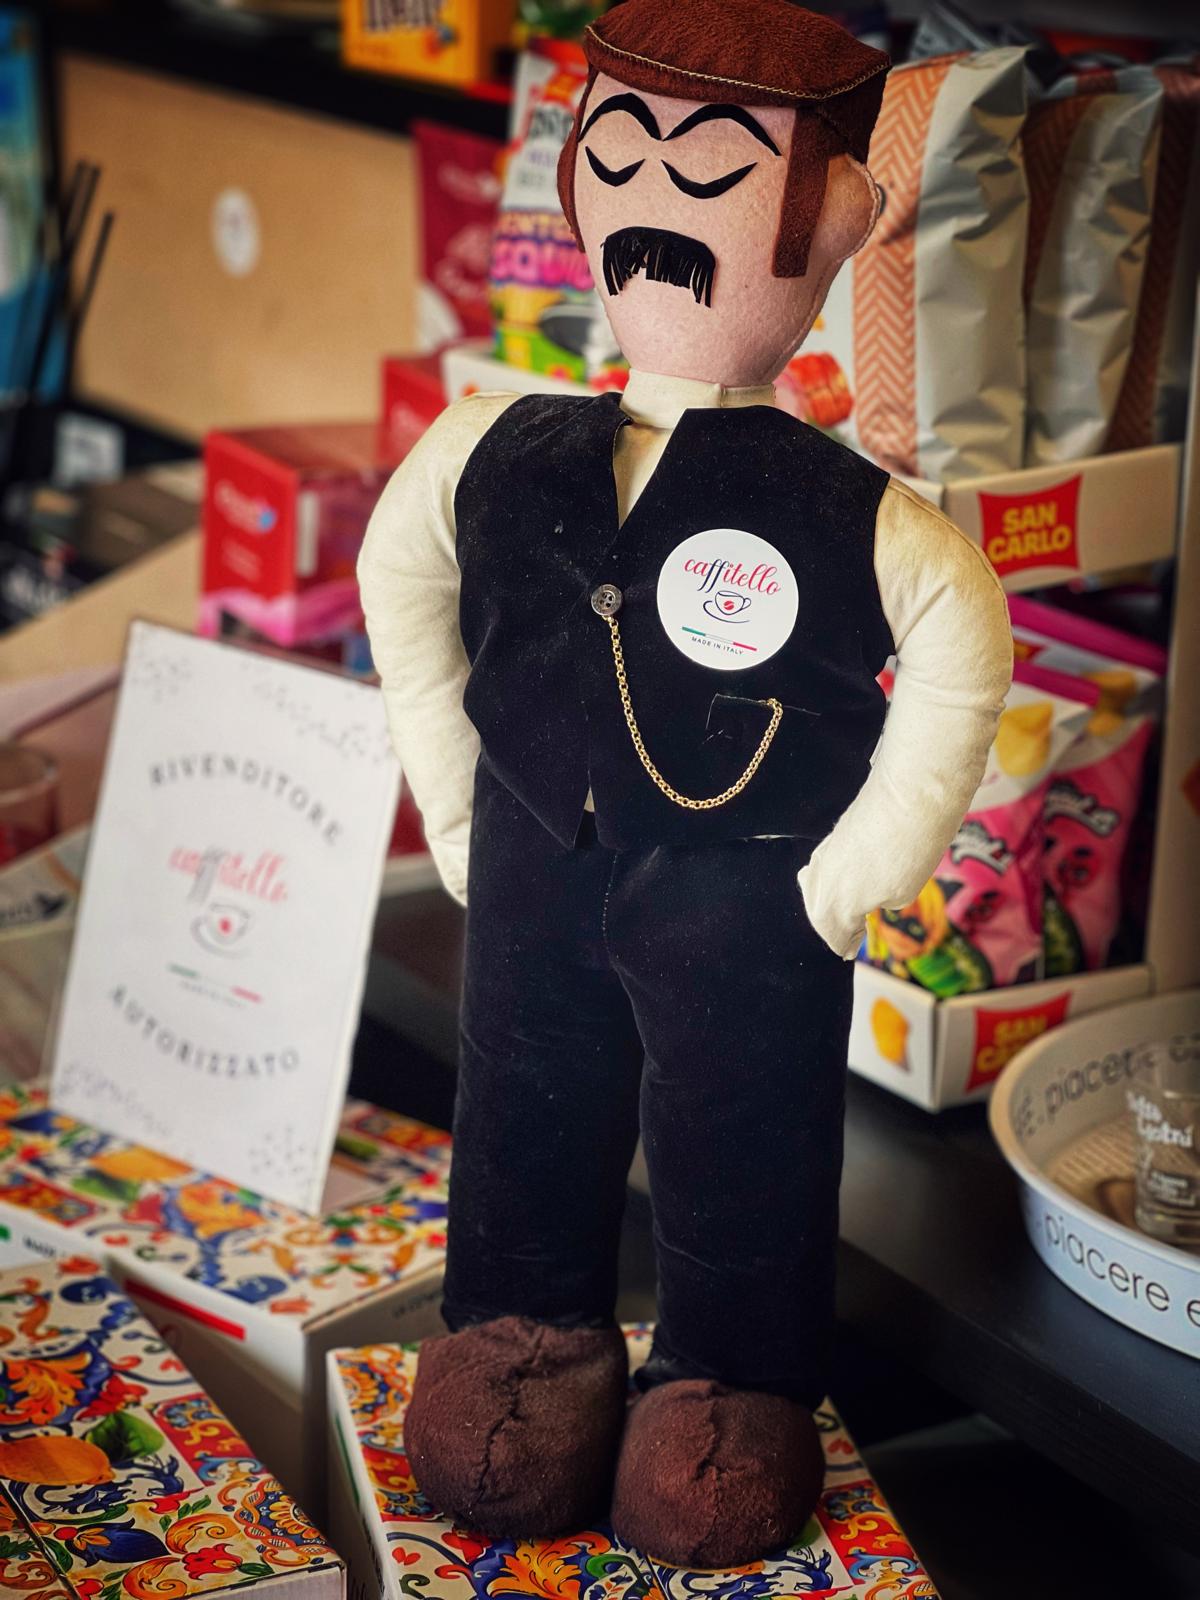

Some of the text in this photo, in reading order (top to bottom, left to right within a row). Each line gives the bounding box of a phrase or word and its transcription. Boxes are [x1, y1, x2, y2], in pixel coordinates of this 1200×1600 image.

[1003, 501, 1057, 535] SAN
[987, 524, 1073, 564] CARLO
[684, 558, 782, 595] caffitello
[691, 636, 745, 655] MADE IN ITALY
[151, 753, 342, 846] RIVENDITORE
[112, 984, 299, 1079] AUTORIZZATO
[1044, 1214, 1171, 1312] piacere
